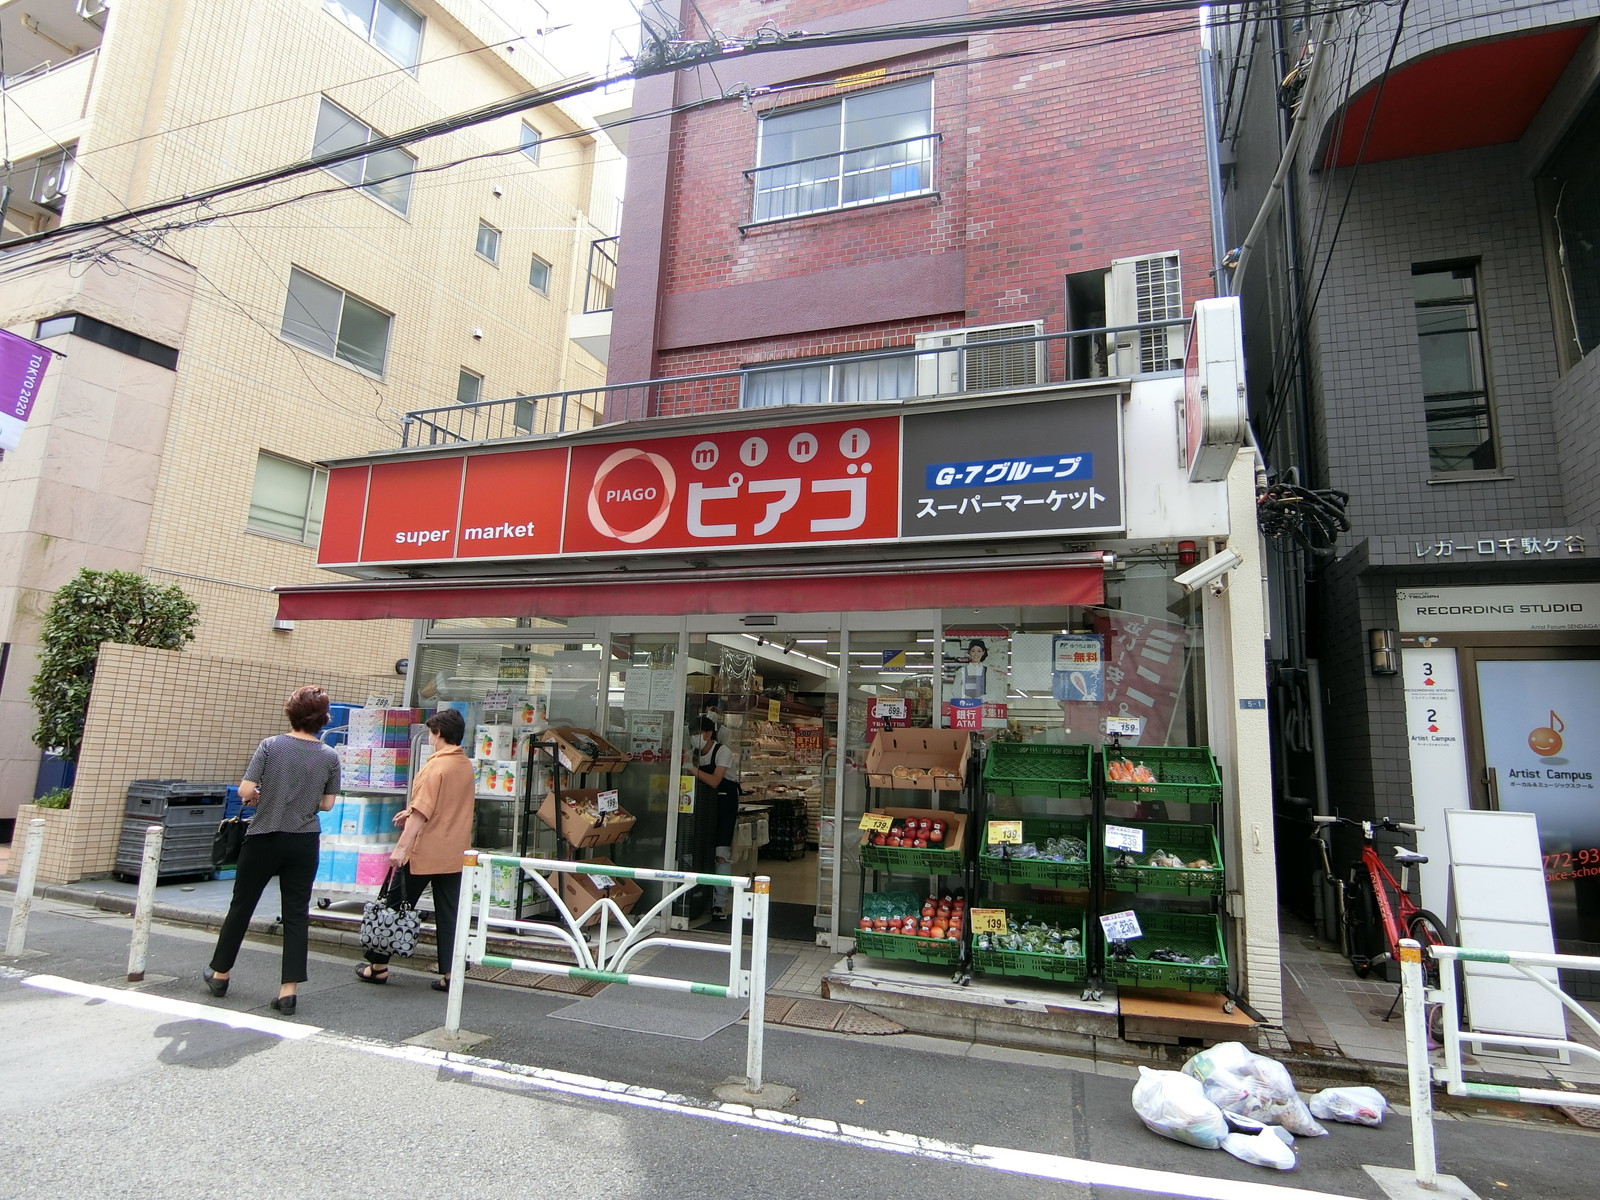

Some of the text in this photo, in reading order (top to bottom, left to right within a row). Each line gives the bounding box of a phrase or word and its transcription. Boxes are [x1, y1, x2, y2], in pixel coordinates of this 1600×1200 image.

[15, 354, 43, 416] TOKYO 2020
[695, 432, 860, 466] mini
[605, 486, 658, 503] PIAGO
[686, 461, 873, 538] ピアゴ
[915, 486, 1106, 519] スーパーマーケット
[395, 521, 534, 545] super market
[1416, 603, 1583, 616] RECORDING STUDIO
[1073, 651, 1098, 662] 無料
[1423, 662, 1433, 676] 3
[375, 698, 389, 708] 289
[888, 706, 900, 715] 699
[956, 709, 977, 720] 銀行
[1427, 709, 1437, 722] 2
[956, 720, 976, 728] ATM
[1121, 724, 1136, 732] 159
[1508, 768, 1593, 782] Artist Campus
[873, 821, 887, 829] 139
[1002, 829, 1017, 839] 139
[1122, 836, 1137, 847] 239
[986, 918, 1002, 929] 139
[1120, 922, 1135, 934] 239
